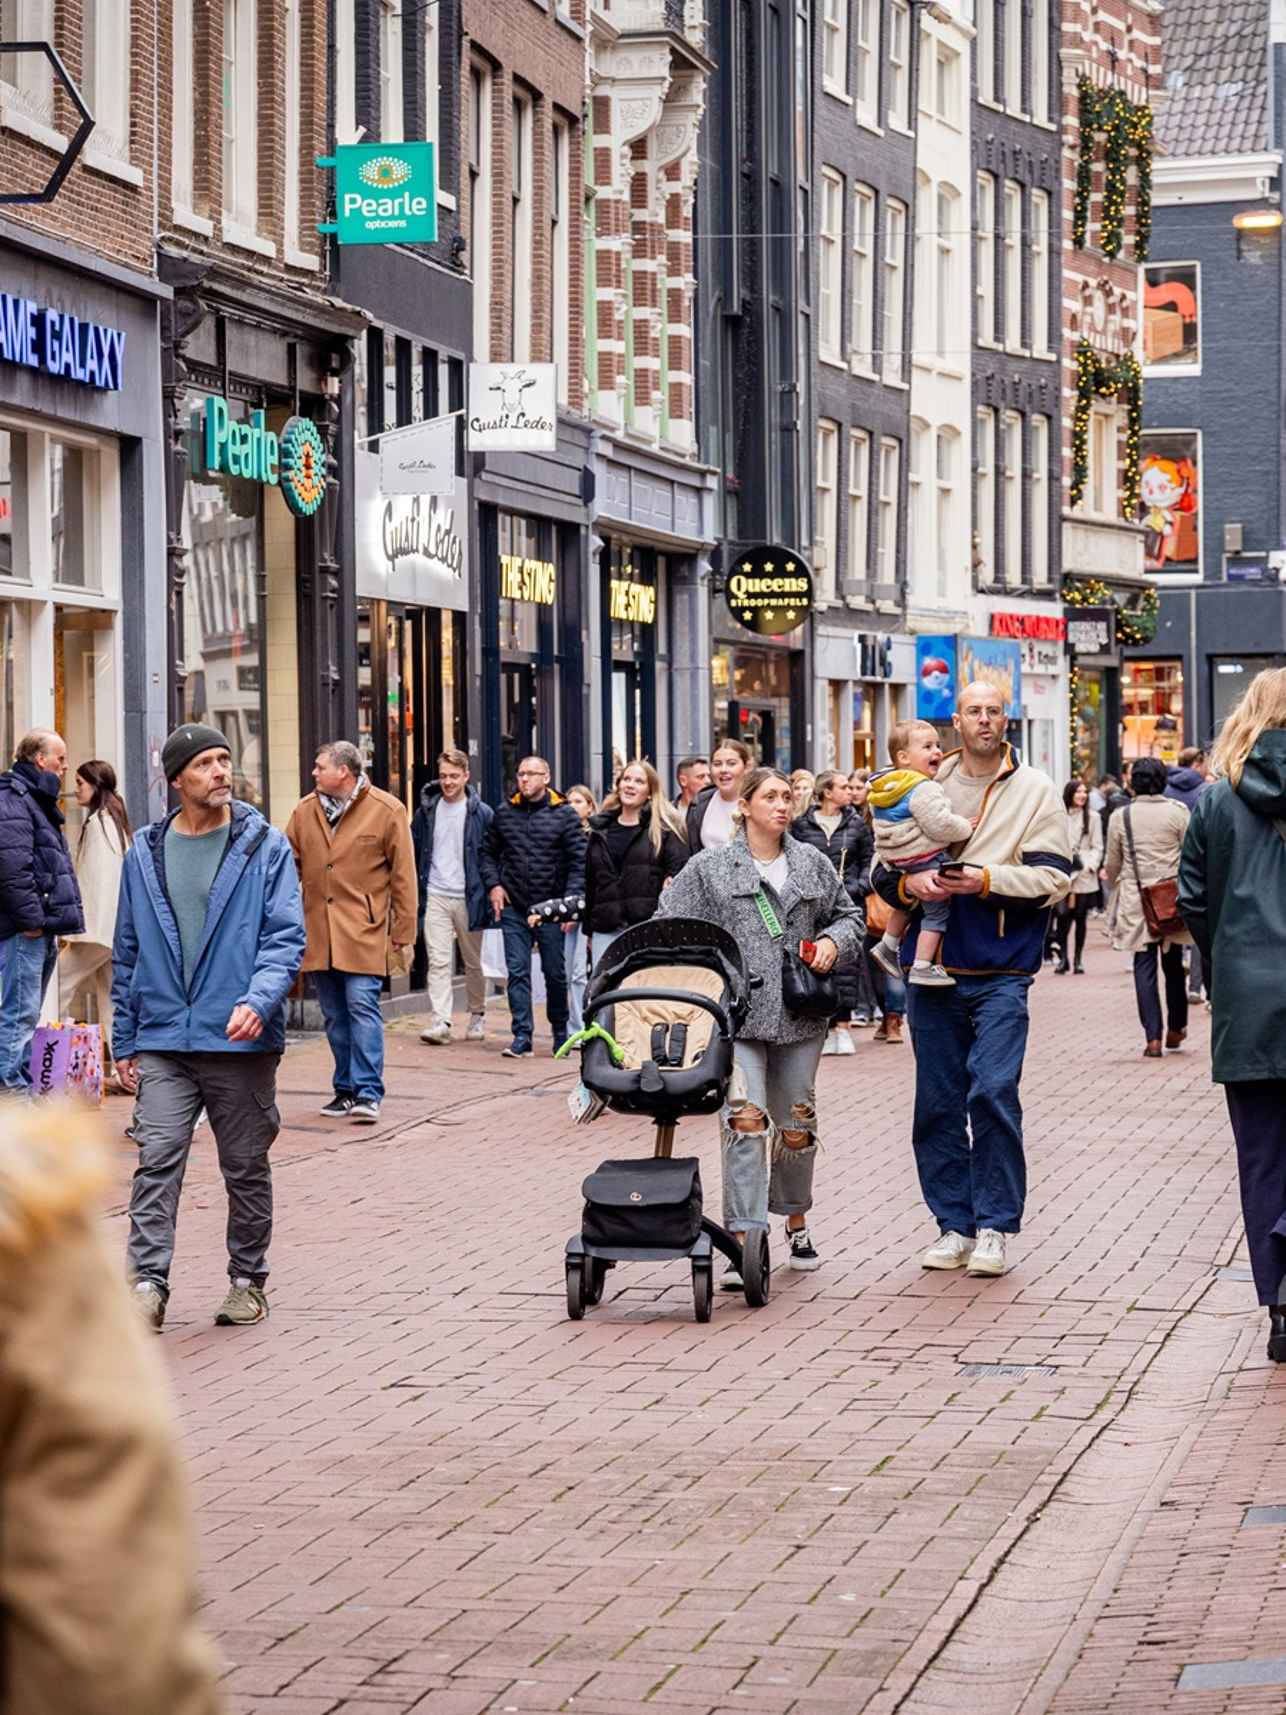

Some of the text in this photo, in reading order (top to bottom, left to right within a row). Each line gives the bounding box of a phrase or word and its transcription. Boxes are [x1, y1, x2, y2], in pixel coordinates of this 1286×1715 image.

[343, 192, 428, 218] Pearle
[364, 217, 408, 231] opticiens
[46, 308, 126, 391] GALAXY
[206, 396, 279, 485] Pearle
[470, 412, 554, 434] Gusti Leder
[383, 495, 463, 578] Gusti Leder
[500, 554, 556, 605] THE STING
[729, 574, 809, 599] Queens
[610, 579, 655, 625] THE STING
[729, 597, 809, 608] STROOPWAFELS
